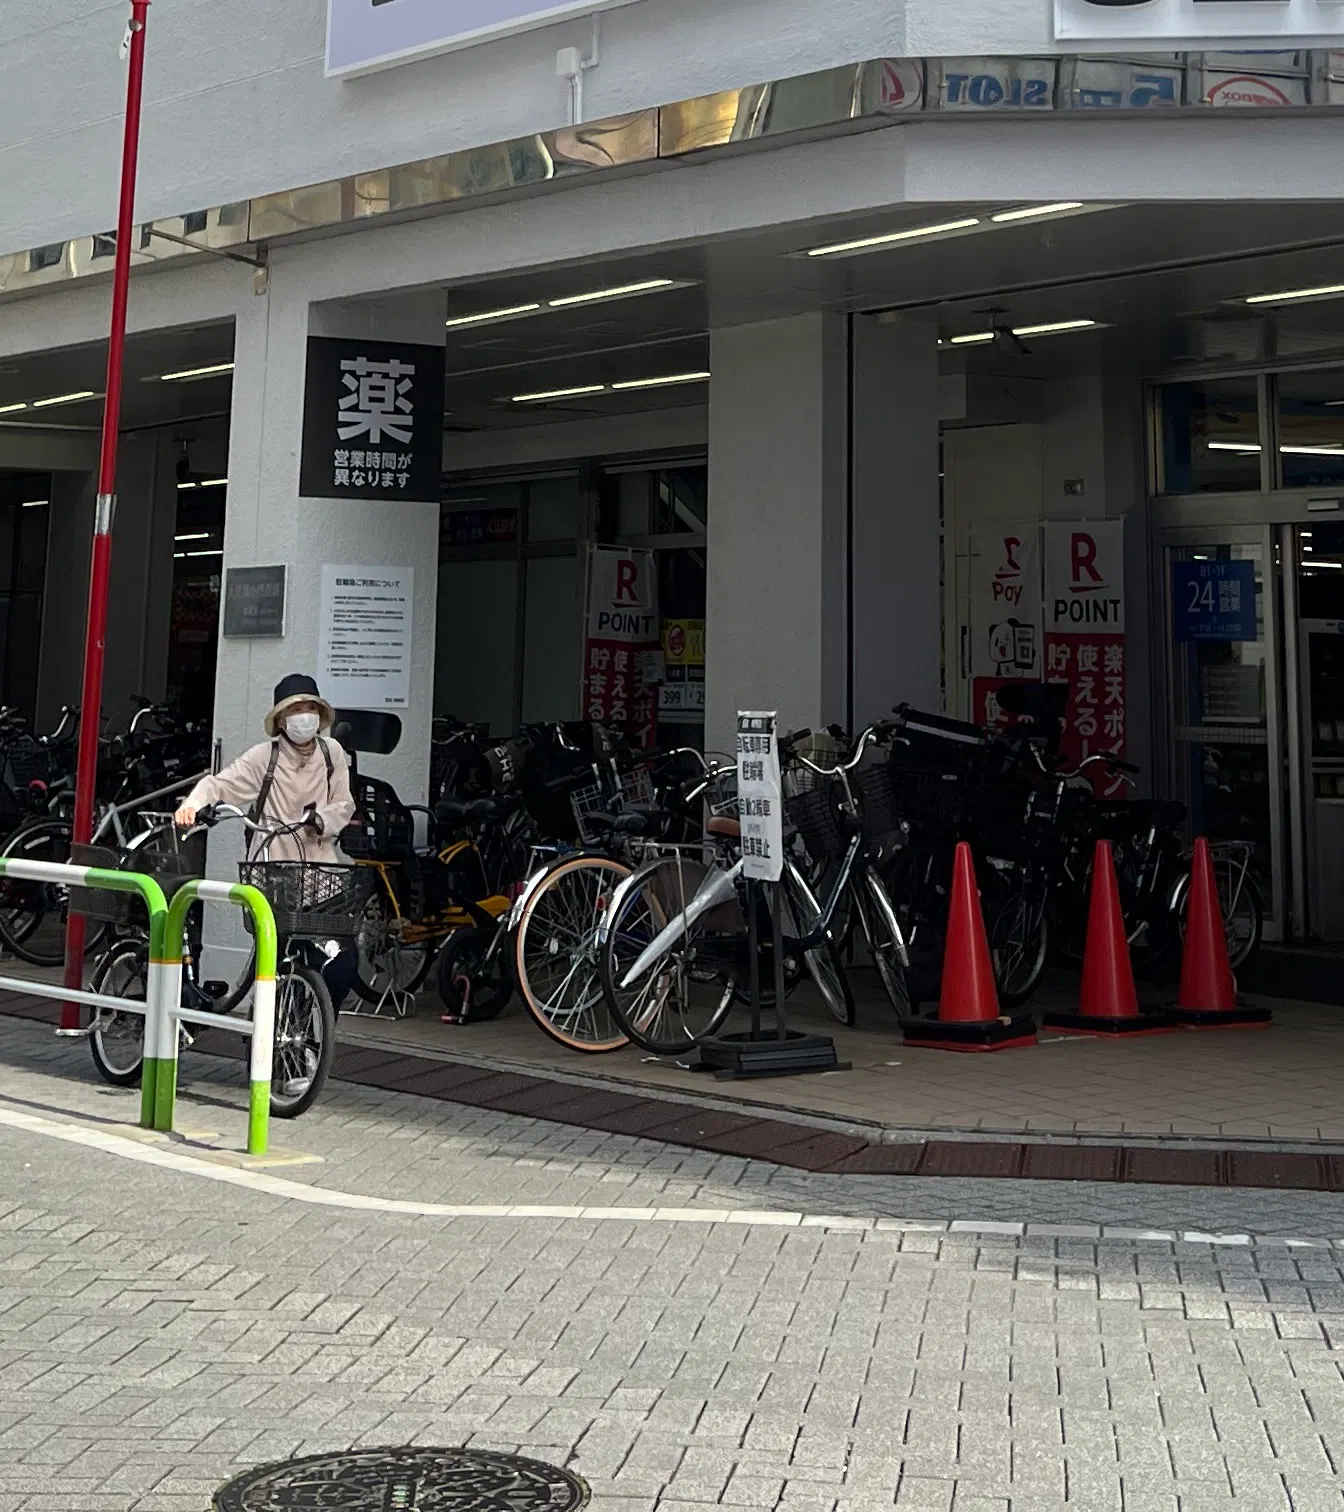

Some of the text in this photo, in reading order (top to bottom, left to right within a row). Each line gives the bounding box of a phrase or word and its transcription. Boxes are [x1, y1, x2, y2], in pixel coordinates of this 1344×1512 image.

[337, 356, 415, 444] 薬
[334, 449, 413, 470] 営業時間が
[334, 468, 411, 488] 異なります
[1071, 532, 1103, 582] R
[616, 559, 638, 602] R
[1187, 580, 1215, 612] 24
[599, 611, 655, 634] POINT
[1054, 599, 1121, 623] POINT
